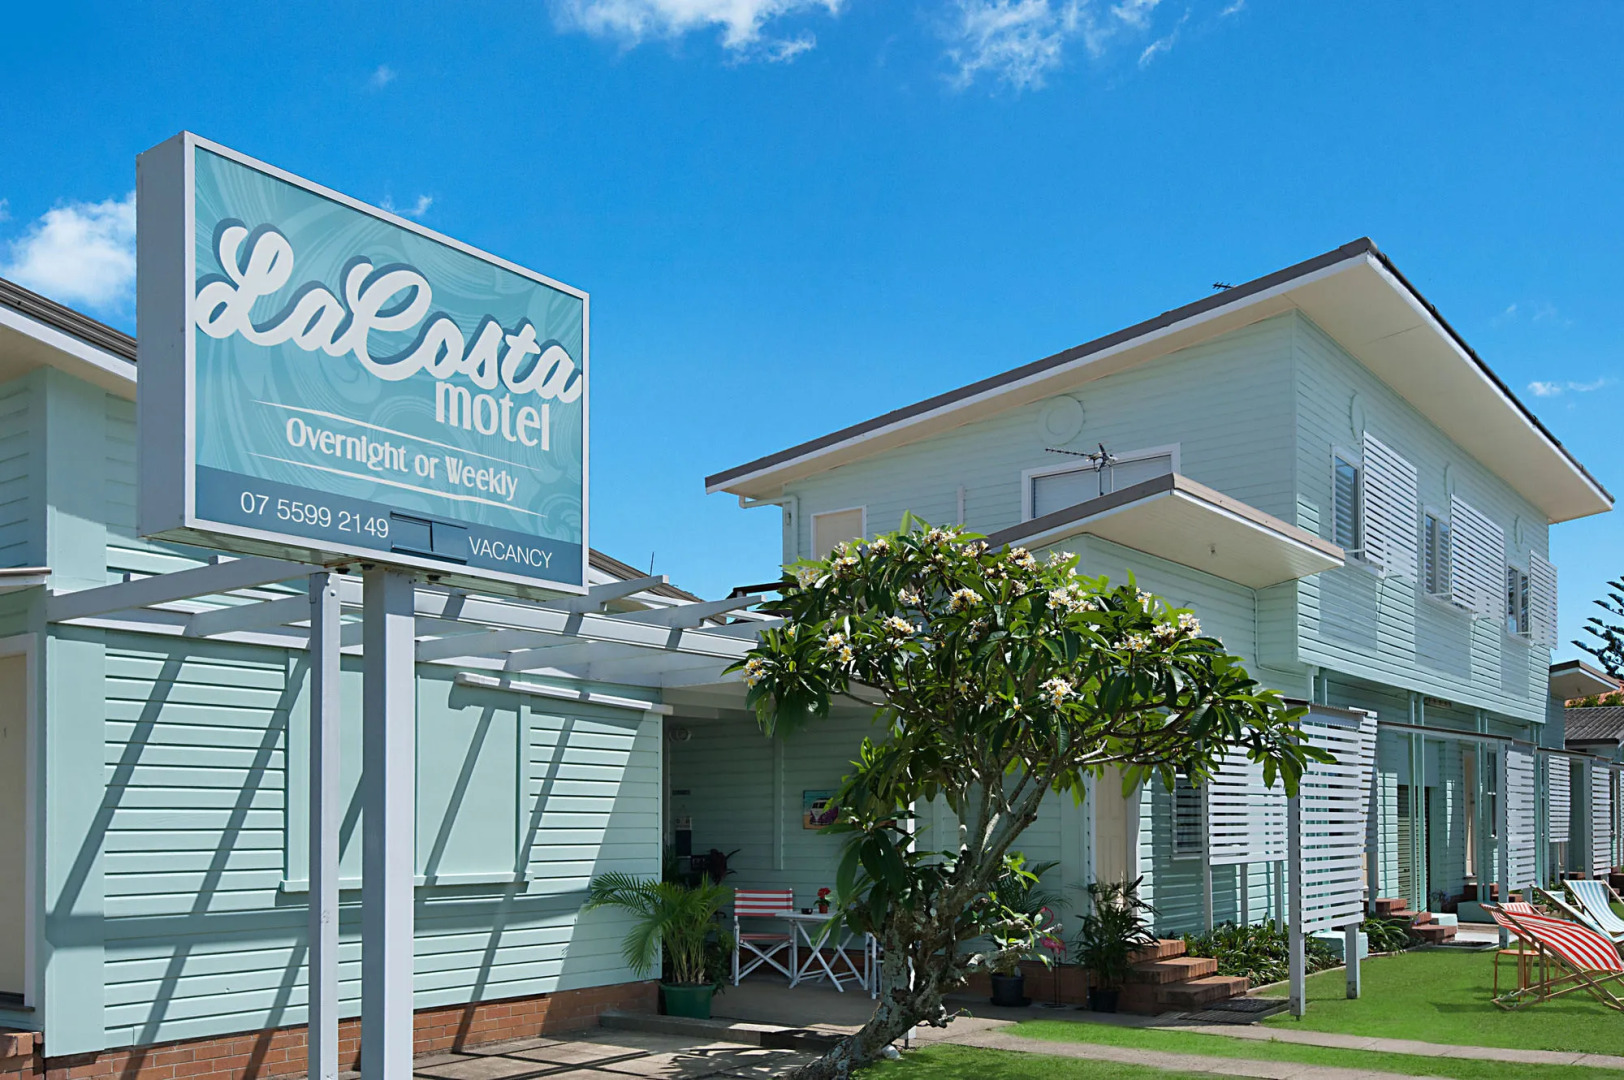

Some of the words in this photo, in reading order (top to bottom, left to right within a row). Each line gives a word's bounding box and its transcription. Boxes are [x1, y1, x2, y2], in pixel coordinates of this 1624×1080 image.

[435, 381, 550, 452] motel
[286, 417, 409, 473] Overnight
[414, 453, 440, 480] or
[445, 455, 519, 501] Weekly
[240, 491, 270, 515] 07
[276, 498, 332, 528] 5599
[337, 510, 389, 538] 2149
[468, 536, 553, 569] VACANCY
